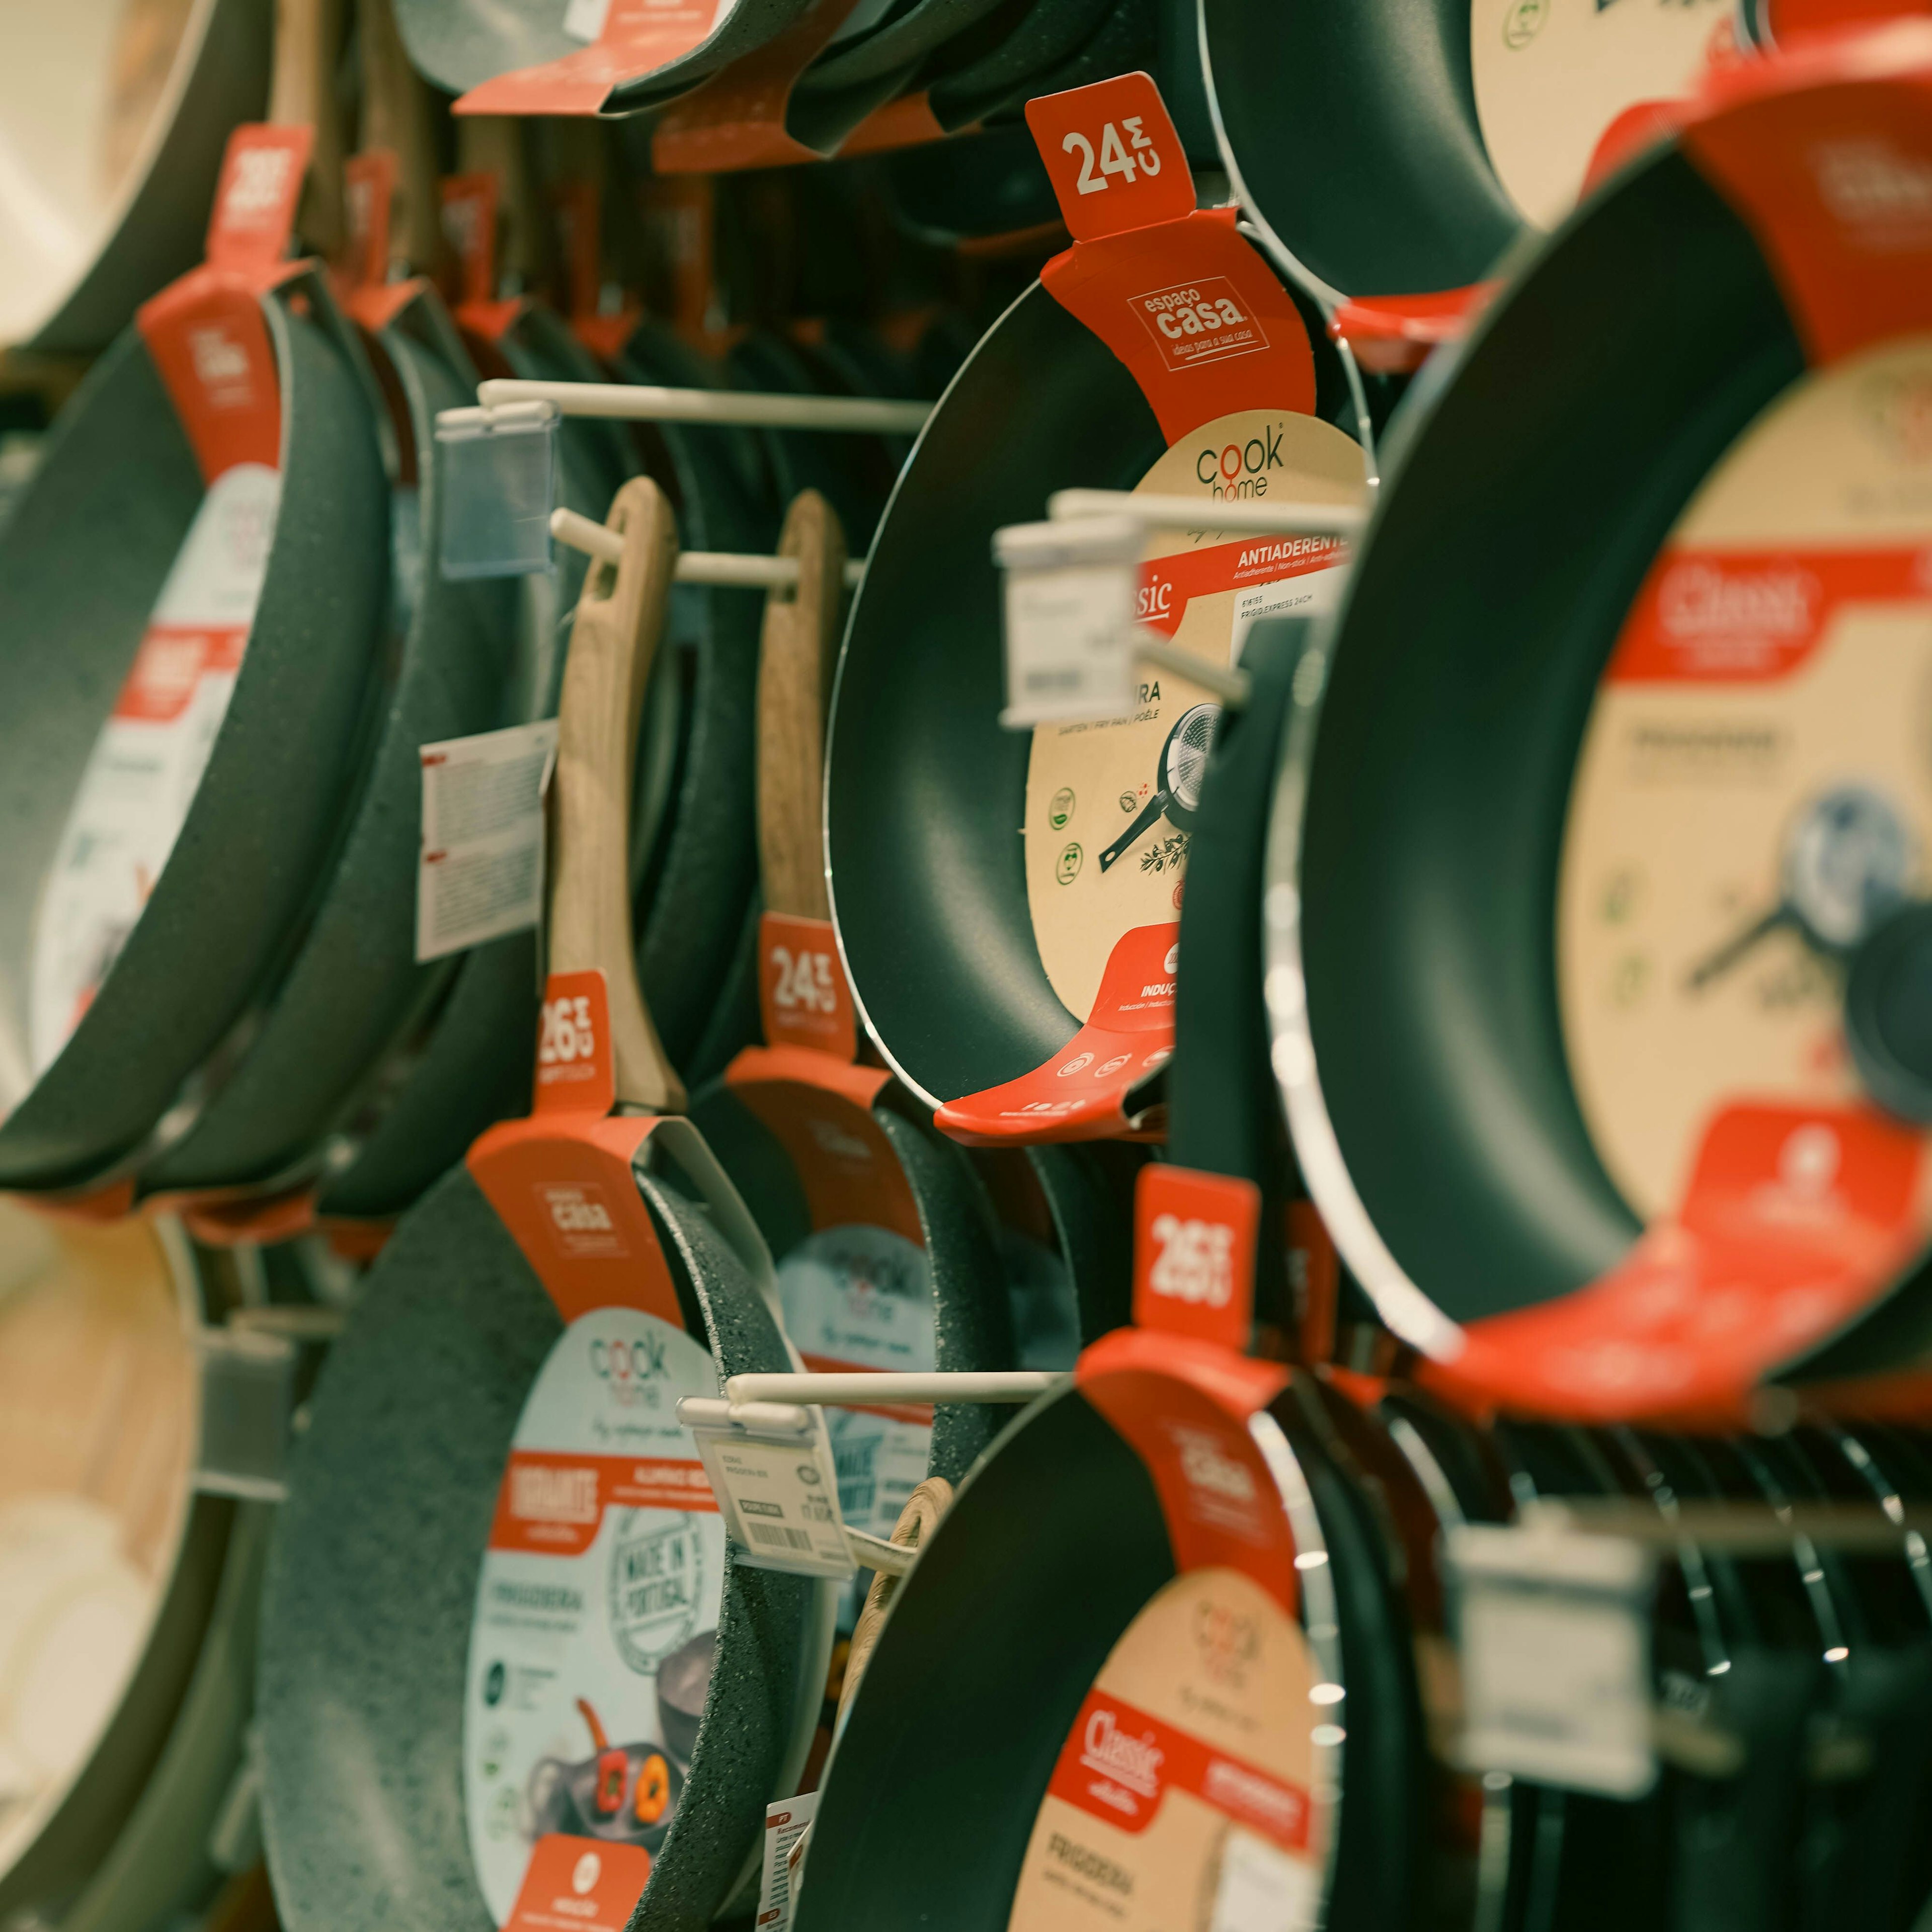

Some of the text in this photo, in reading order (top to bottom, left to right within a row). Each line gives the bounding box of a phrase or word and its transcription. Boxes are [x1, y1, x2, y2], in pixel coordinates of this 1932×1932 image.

[1062, 122, 1136, 195] 24
[1144, 288, 1201, 312] espaço
[1157, 298, 1245, 339] casa
[1234, 330, 1253, 341] casa
[1197, 425, 1284, 484] cook
[1213, 476, 1267, 504] home
[1141, 982, 1177, 997] INDUÇ
